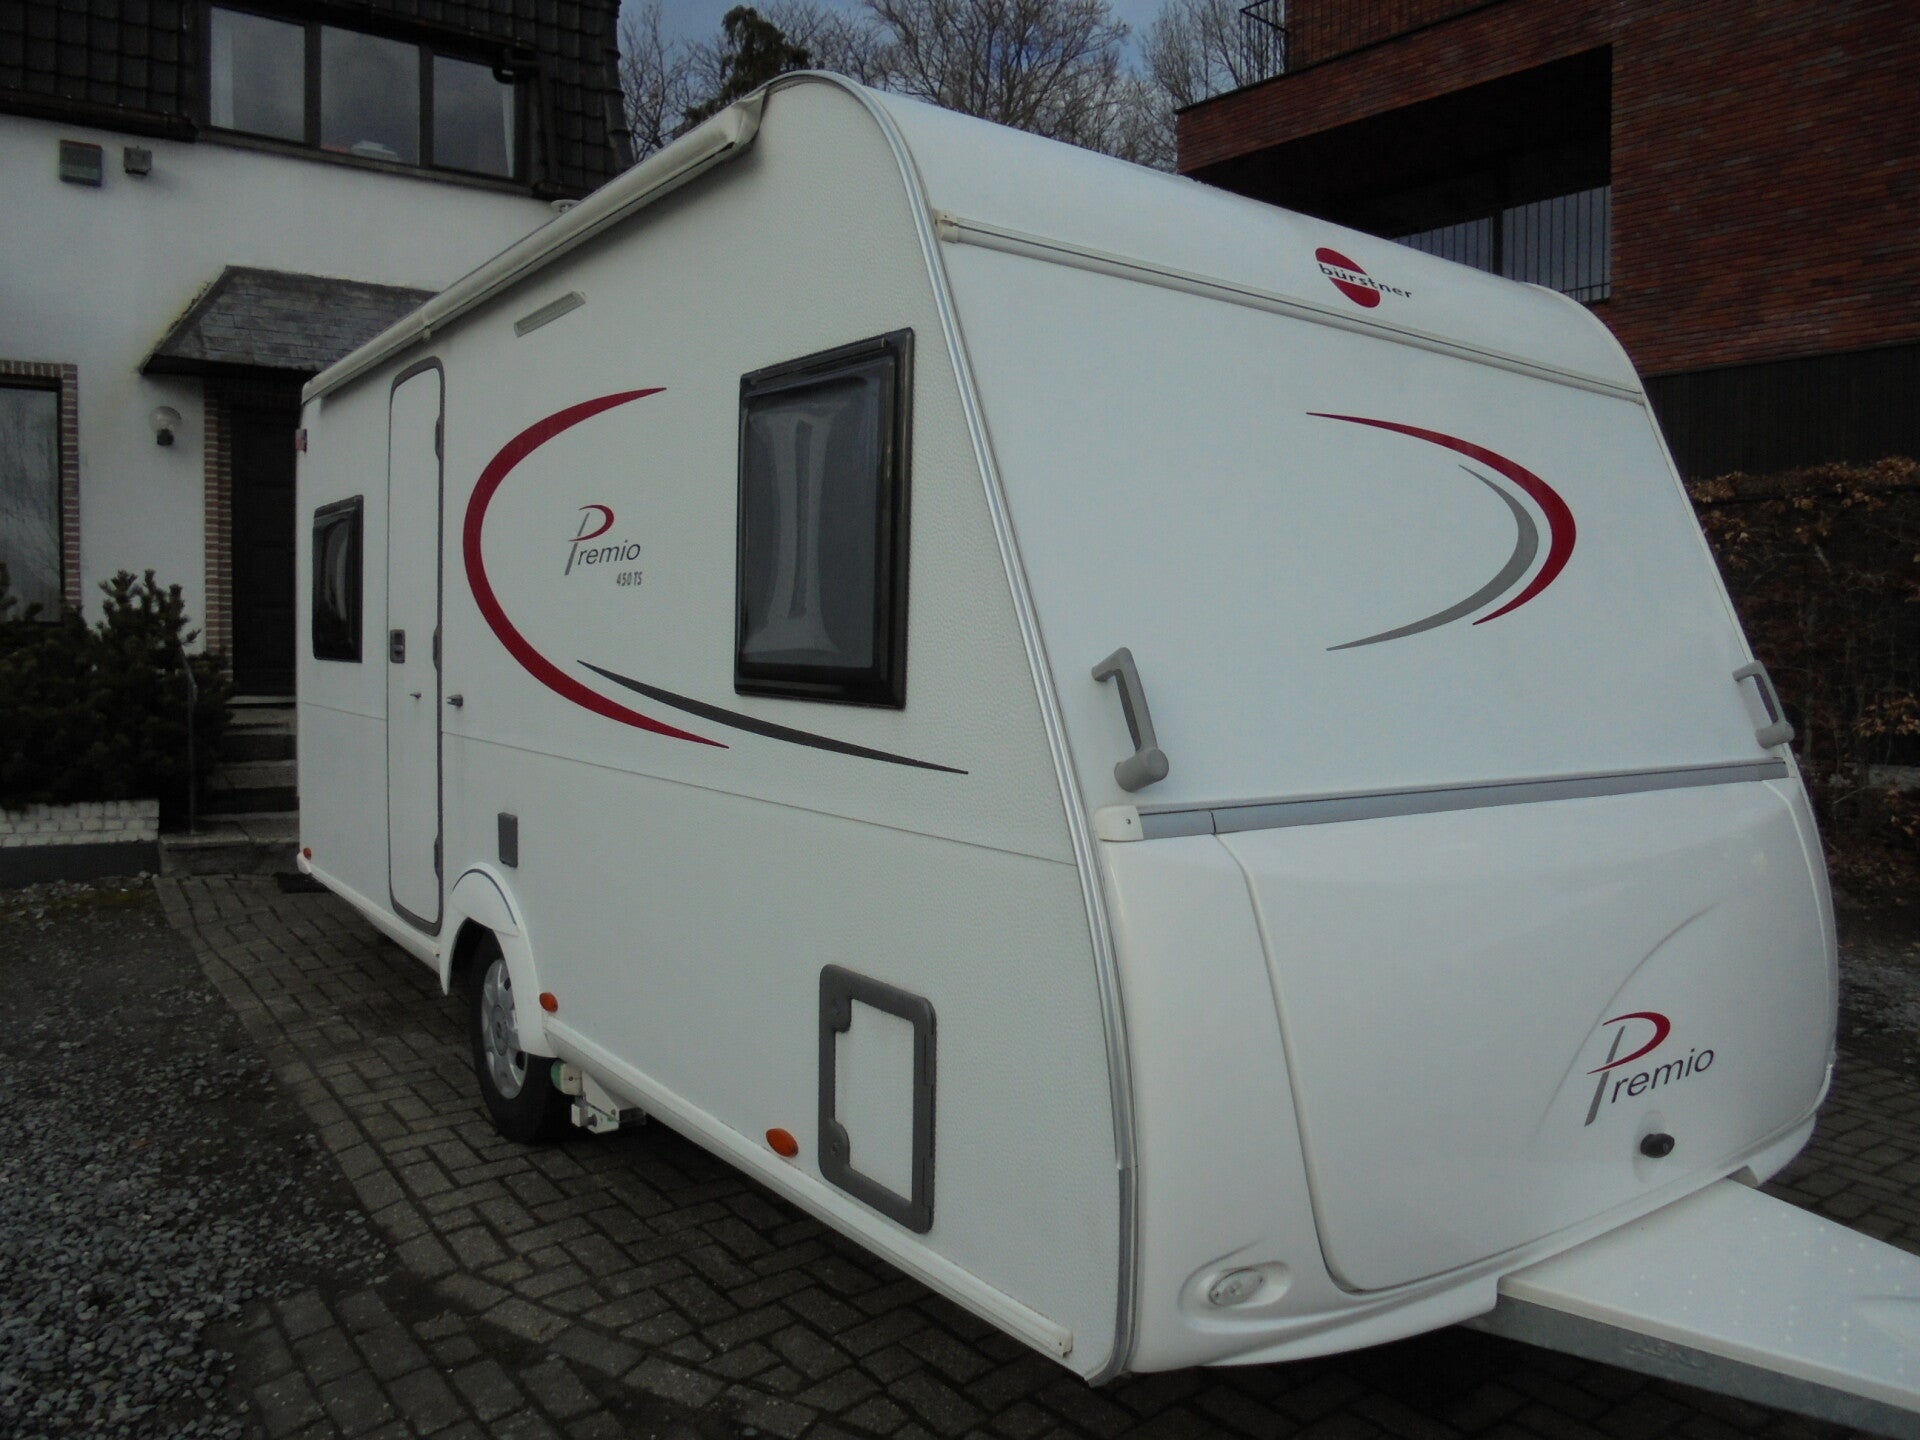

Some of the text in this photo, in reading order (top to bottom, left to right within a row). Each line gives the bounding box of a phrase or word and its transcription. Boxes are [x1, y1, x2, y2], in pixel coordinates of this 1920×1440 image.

[1318, 262, 1413, 298] bürstner
[564, 504, 641, 576] Premio
[1584, 1011, 1715, 1127] Premio
